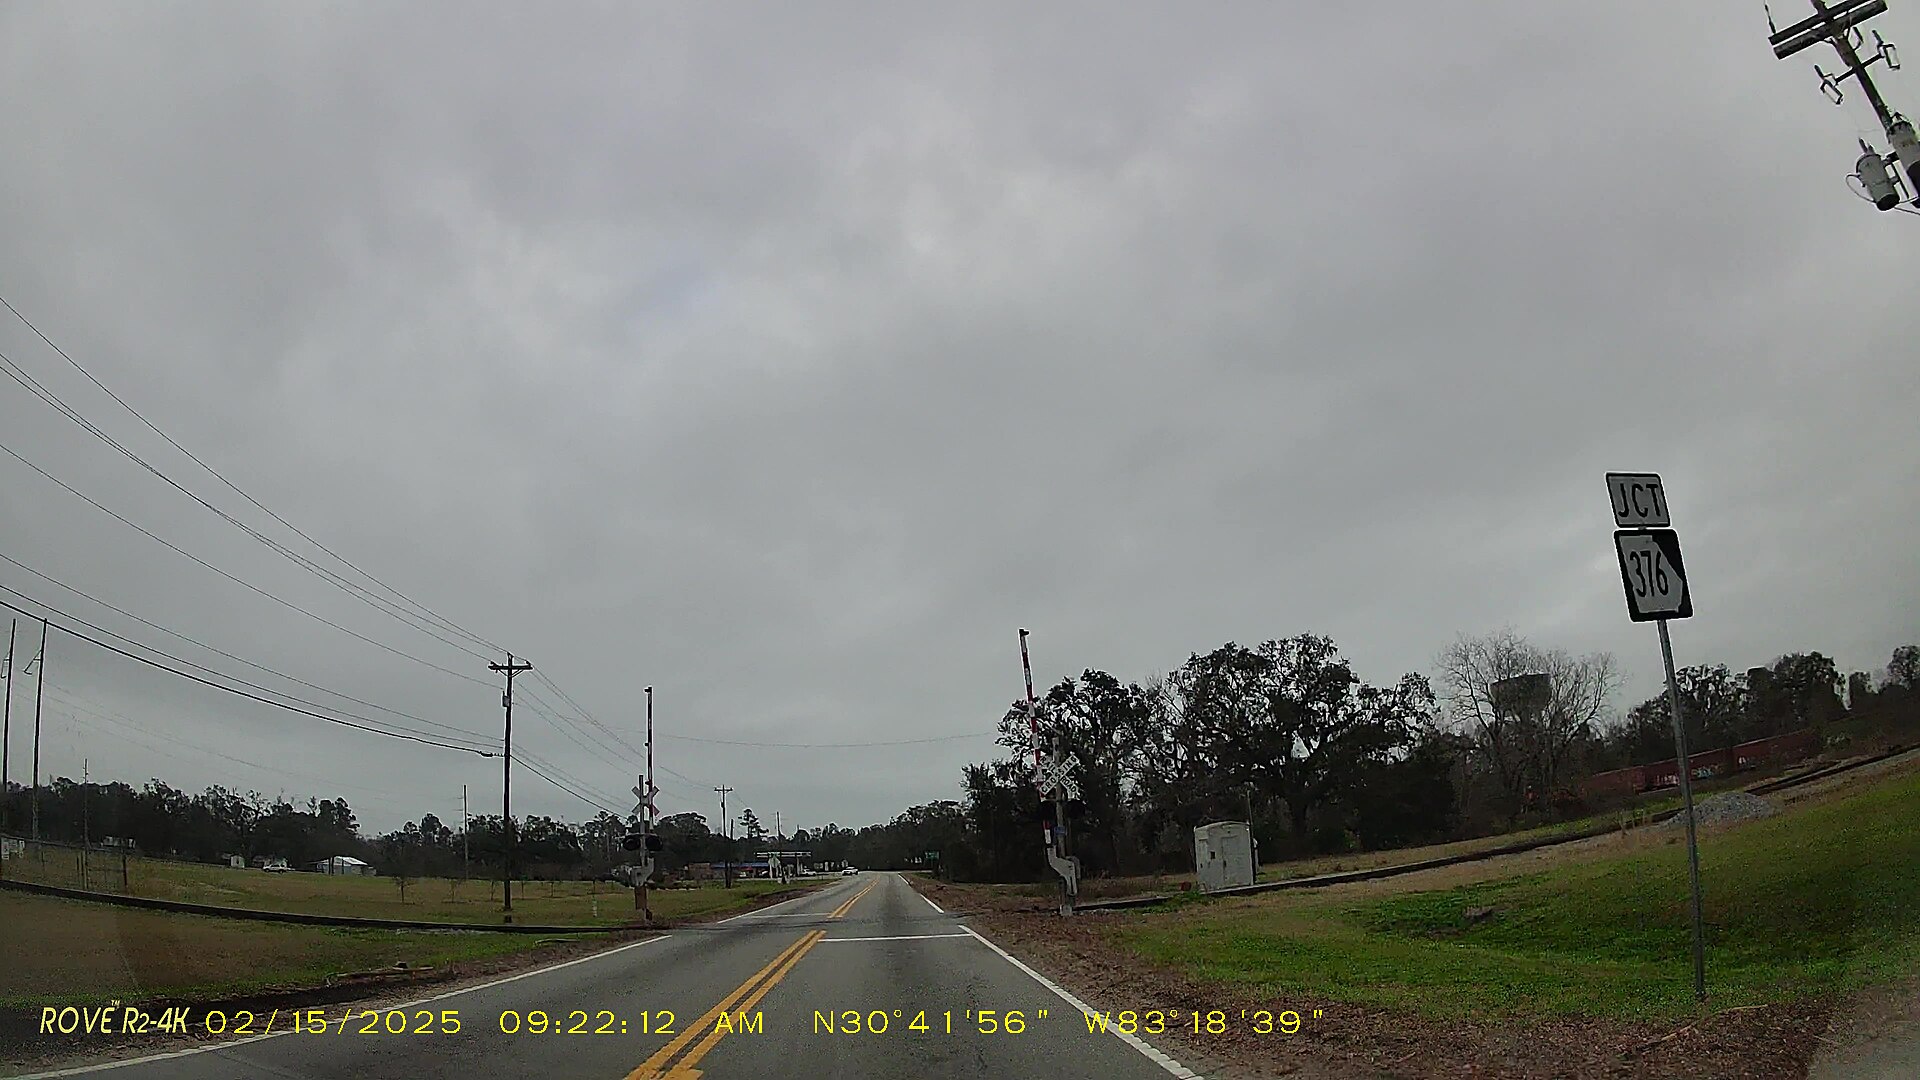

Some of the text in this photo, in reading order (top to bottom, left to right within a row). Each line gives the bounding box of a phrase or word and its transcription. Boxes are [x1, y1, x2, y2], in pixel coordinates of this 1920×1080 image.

[1617, 483, 1662, 518] JCT
[1629, 550, 1670, 598] 376
[1039, 755, 1077, 793] RAIL ROAD
[1040, 755, 1078, 793] CROSSING
